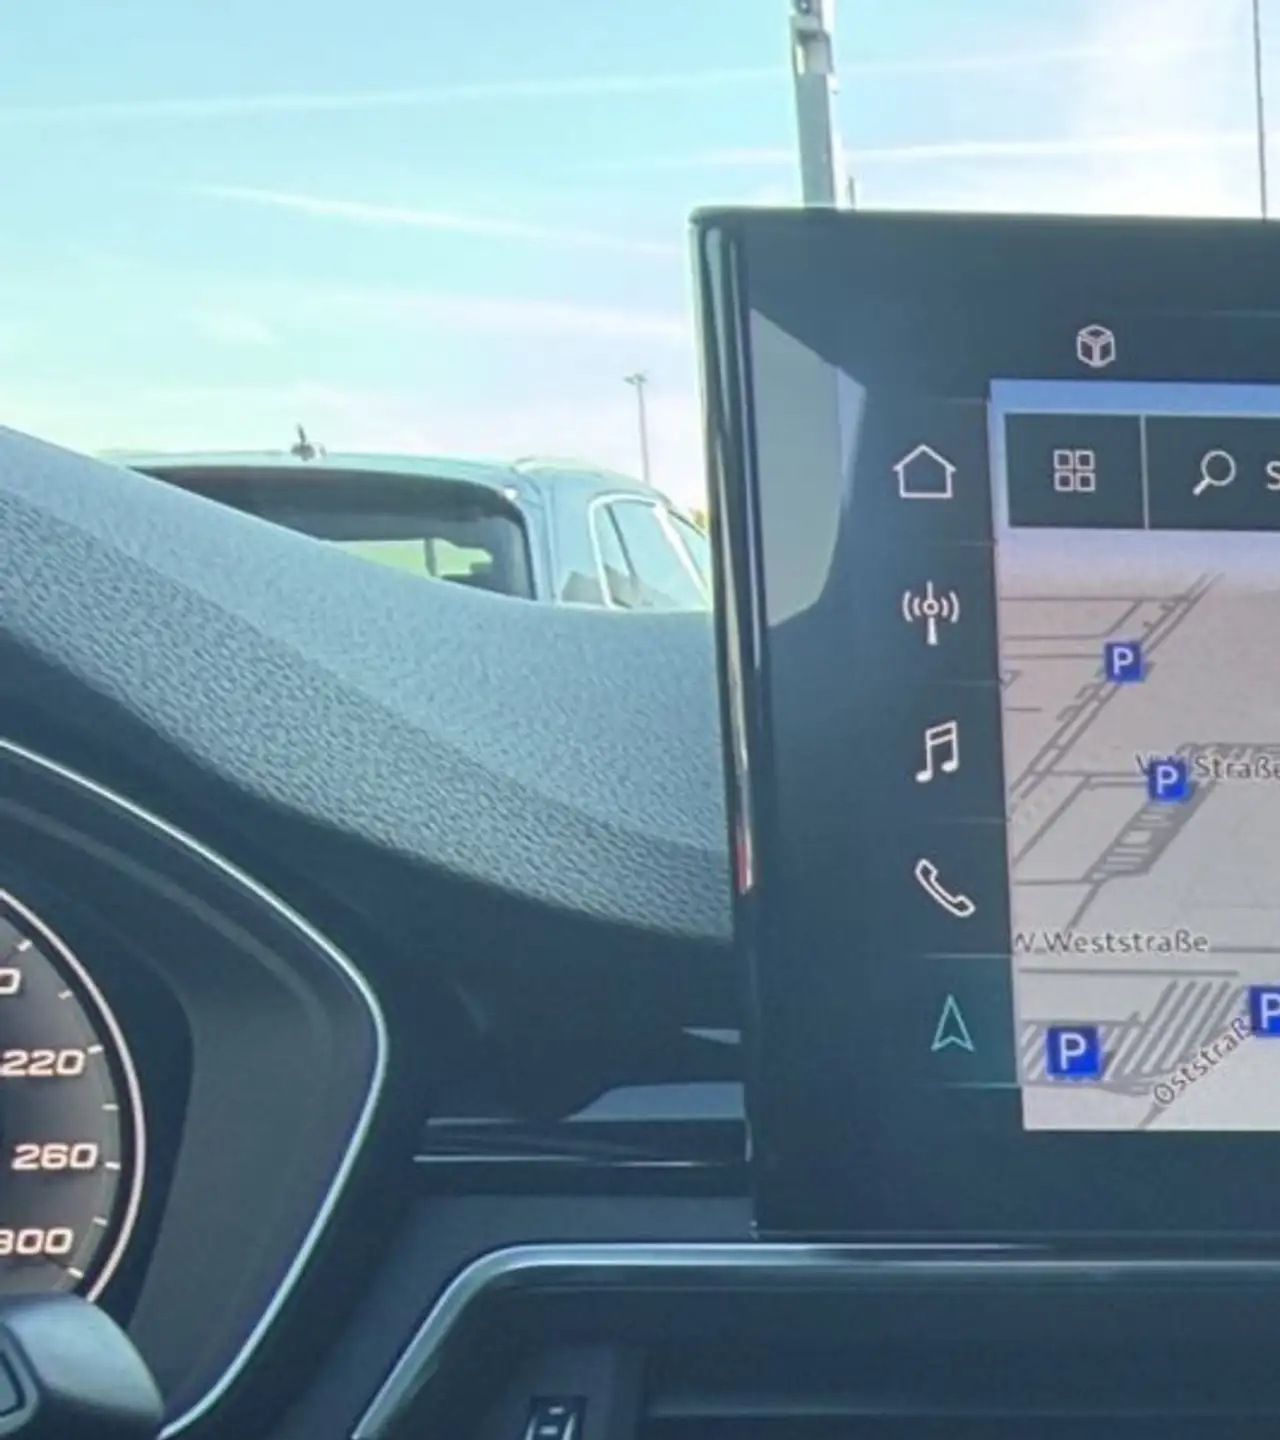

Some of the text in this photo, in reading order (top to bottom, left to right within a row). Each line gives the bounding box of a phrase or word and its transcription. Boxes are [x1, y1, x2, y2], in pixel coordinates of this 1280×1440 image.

[1043, 929, 1210, 954] Weststraße
[0, 1048, 85, 1076] 220
[1153, 1016, 1254, 1105] Oststraß
[12, 1143, 99, 1170] 260
